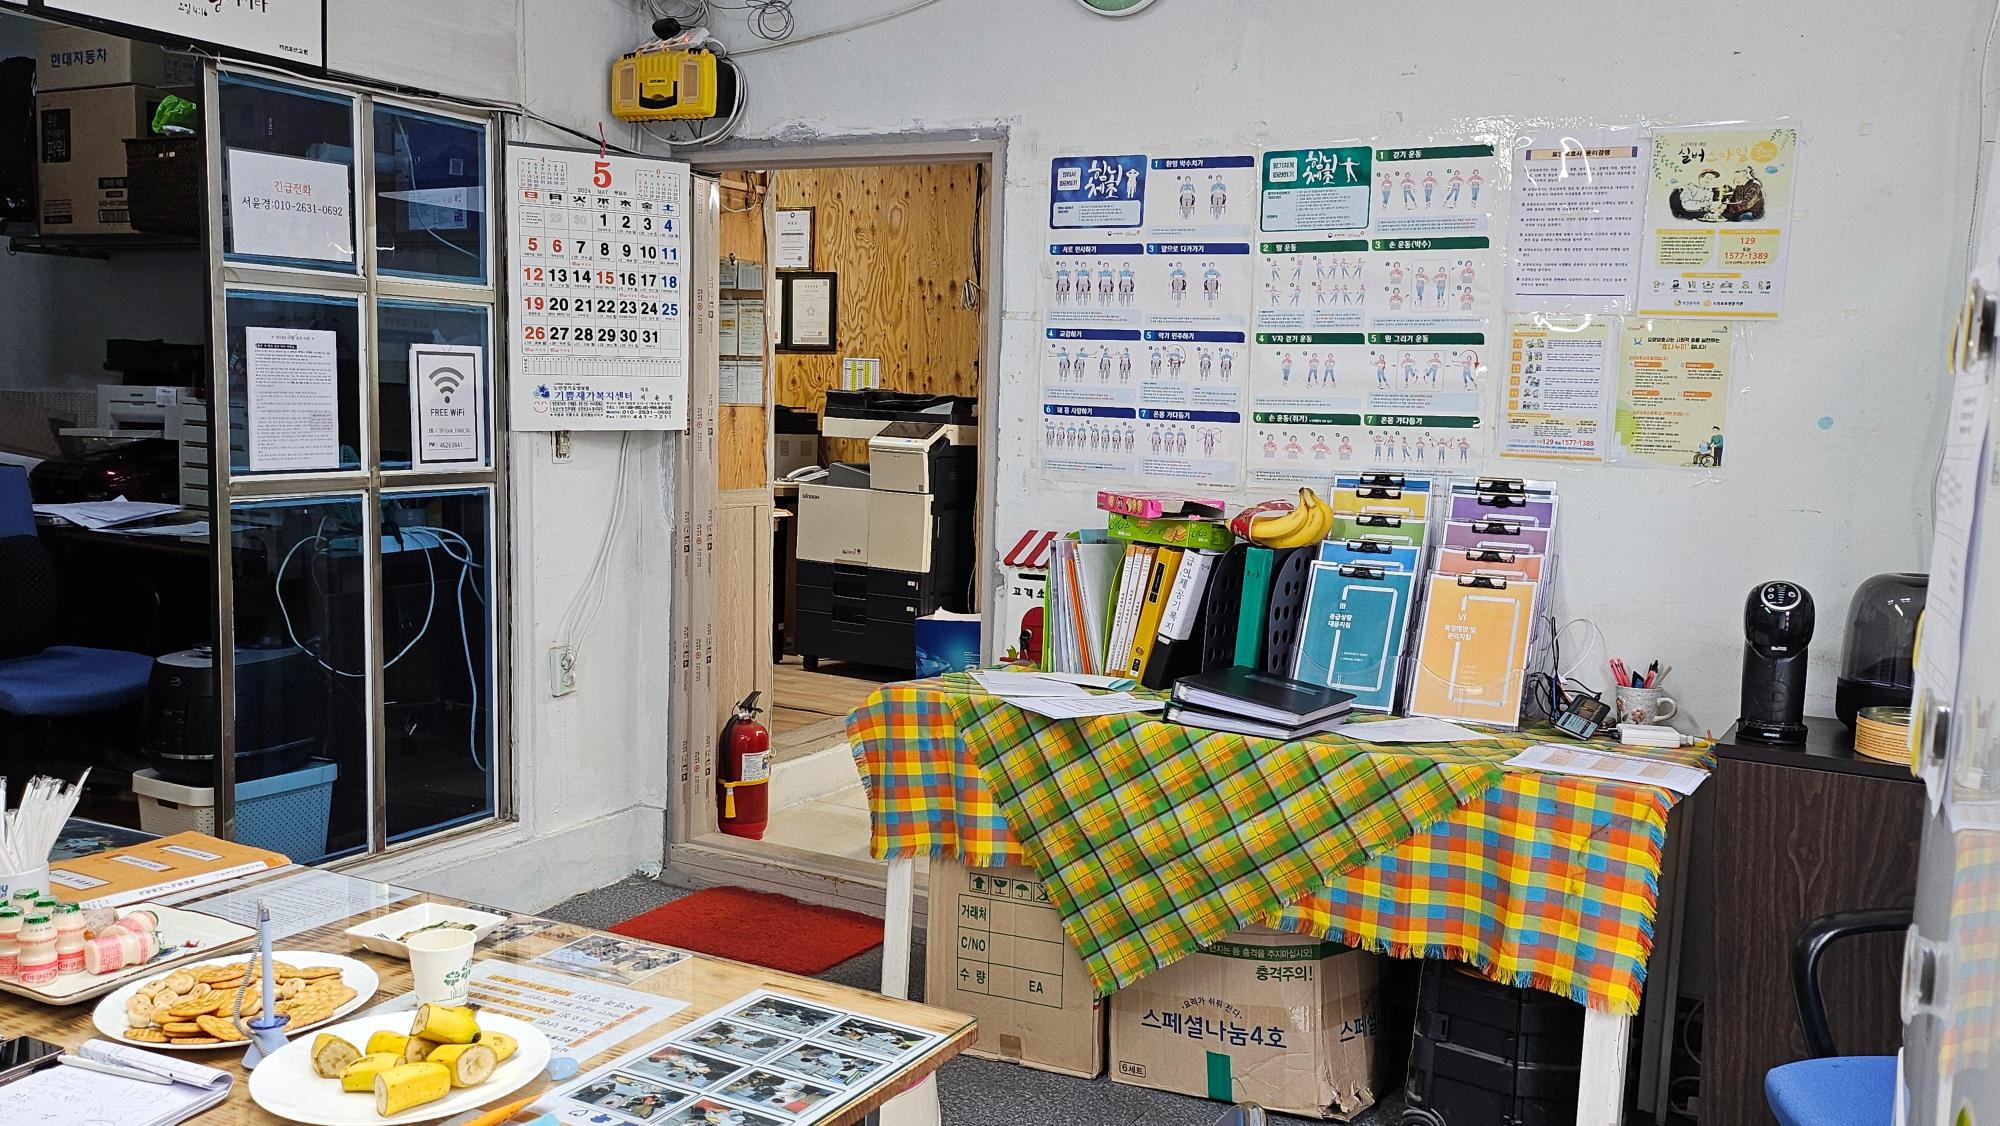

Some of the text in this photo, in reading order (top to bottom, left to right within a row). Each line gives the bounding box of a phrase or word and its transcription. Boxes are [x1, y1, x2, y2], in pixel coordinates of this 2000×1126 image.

[1392, 150, 1406, 159] 걷기
[1408, 149, 1421, 158] 운동
[1677, 147, 1705, 165] 실버
[1179, 159, 1204, 168] 박수치기
[593, 161, 612, 189] 5
[274, 181, 311, 195] 긴급전화
[573, 195, 586, 203] 火
[600, 213, 607, 227] 1
[622, 215, 631, 229] 2
[643, 217, 651, 231] 3
[664, 219, 673, 232] 4
[1388, 241, 1395, 249] 손
[1397, 240, 1431, 250] 운동(박수)
[1740, 237, 1755, 245] 129
[527, 237, 677, 261] 5 6 7 8 9 10 11
[1062, 245, 1073, 253] 서로
[1180, 245, 1204, 253] 다가가기
[1284, 243, 1297, 251] 운동
[1724, 252, 1768, 260] 1577-1389
[524, 267, 678, 289] 12 13 14 15 16 17 18
[525, 296, 679, 317] 19 20 21 22 23 24 25
[524, 326, 658, 344] 26 27 28 29 30 31
[1284, 334, 1298, 343] 걷기
[1299, 334, 1312, 343] 운동
[1384, 335, 1392, 343] 원
[1393, 335, 1414, 343] 그리기
[1415, 335, 1429, 343] 운동
[555, 391, 633, 402] 기쁨재가복지센터
[430, 408, 466, 417] FREE WiFi
[1166, 411, 1191, 420] 가다듬기
[1268, 413, 1276, 423] 손
[1276, 413, 1308, 423] 운동(쥐기)
[1380, 416, 1394, 425] 온몸
[1395, 417, 1423, 426] 가다듬기
[1561, 439, 1595, 447] 1577-1389
[961, 904, 987, 922] 거래처
[961, 937, 986, 952] C/NO
[1242, 948, 1265, 958] 충격을
[1269, 948, 1313, 958] 주지마십시오!
[1255, 965, 1313, 982] 충격주의!
[1029, 980, 1044, 994] EA
[1208, 997, 1223, 1008] 쉬워
[1140, 1008, 1287, 1049] 스페셜나눔4호
[1121, 1064, 1144, 1076] 6세트
